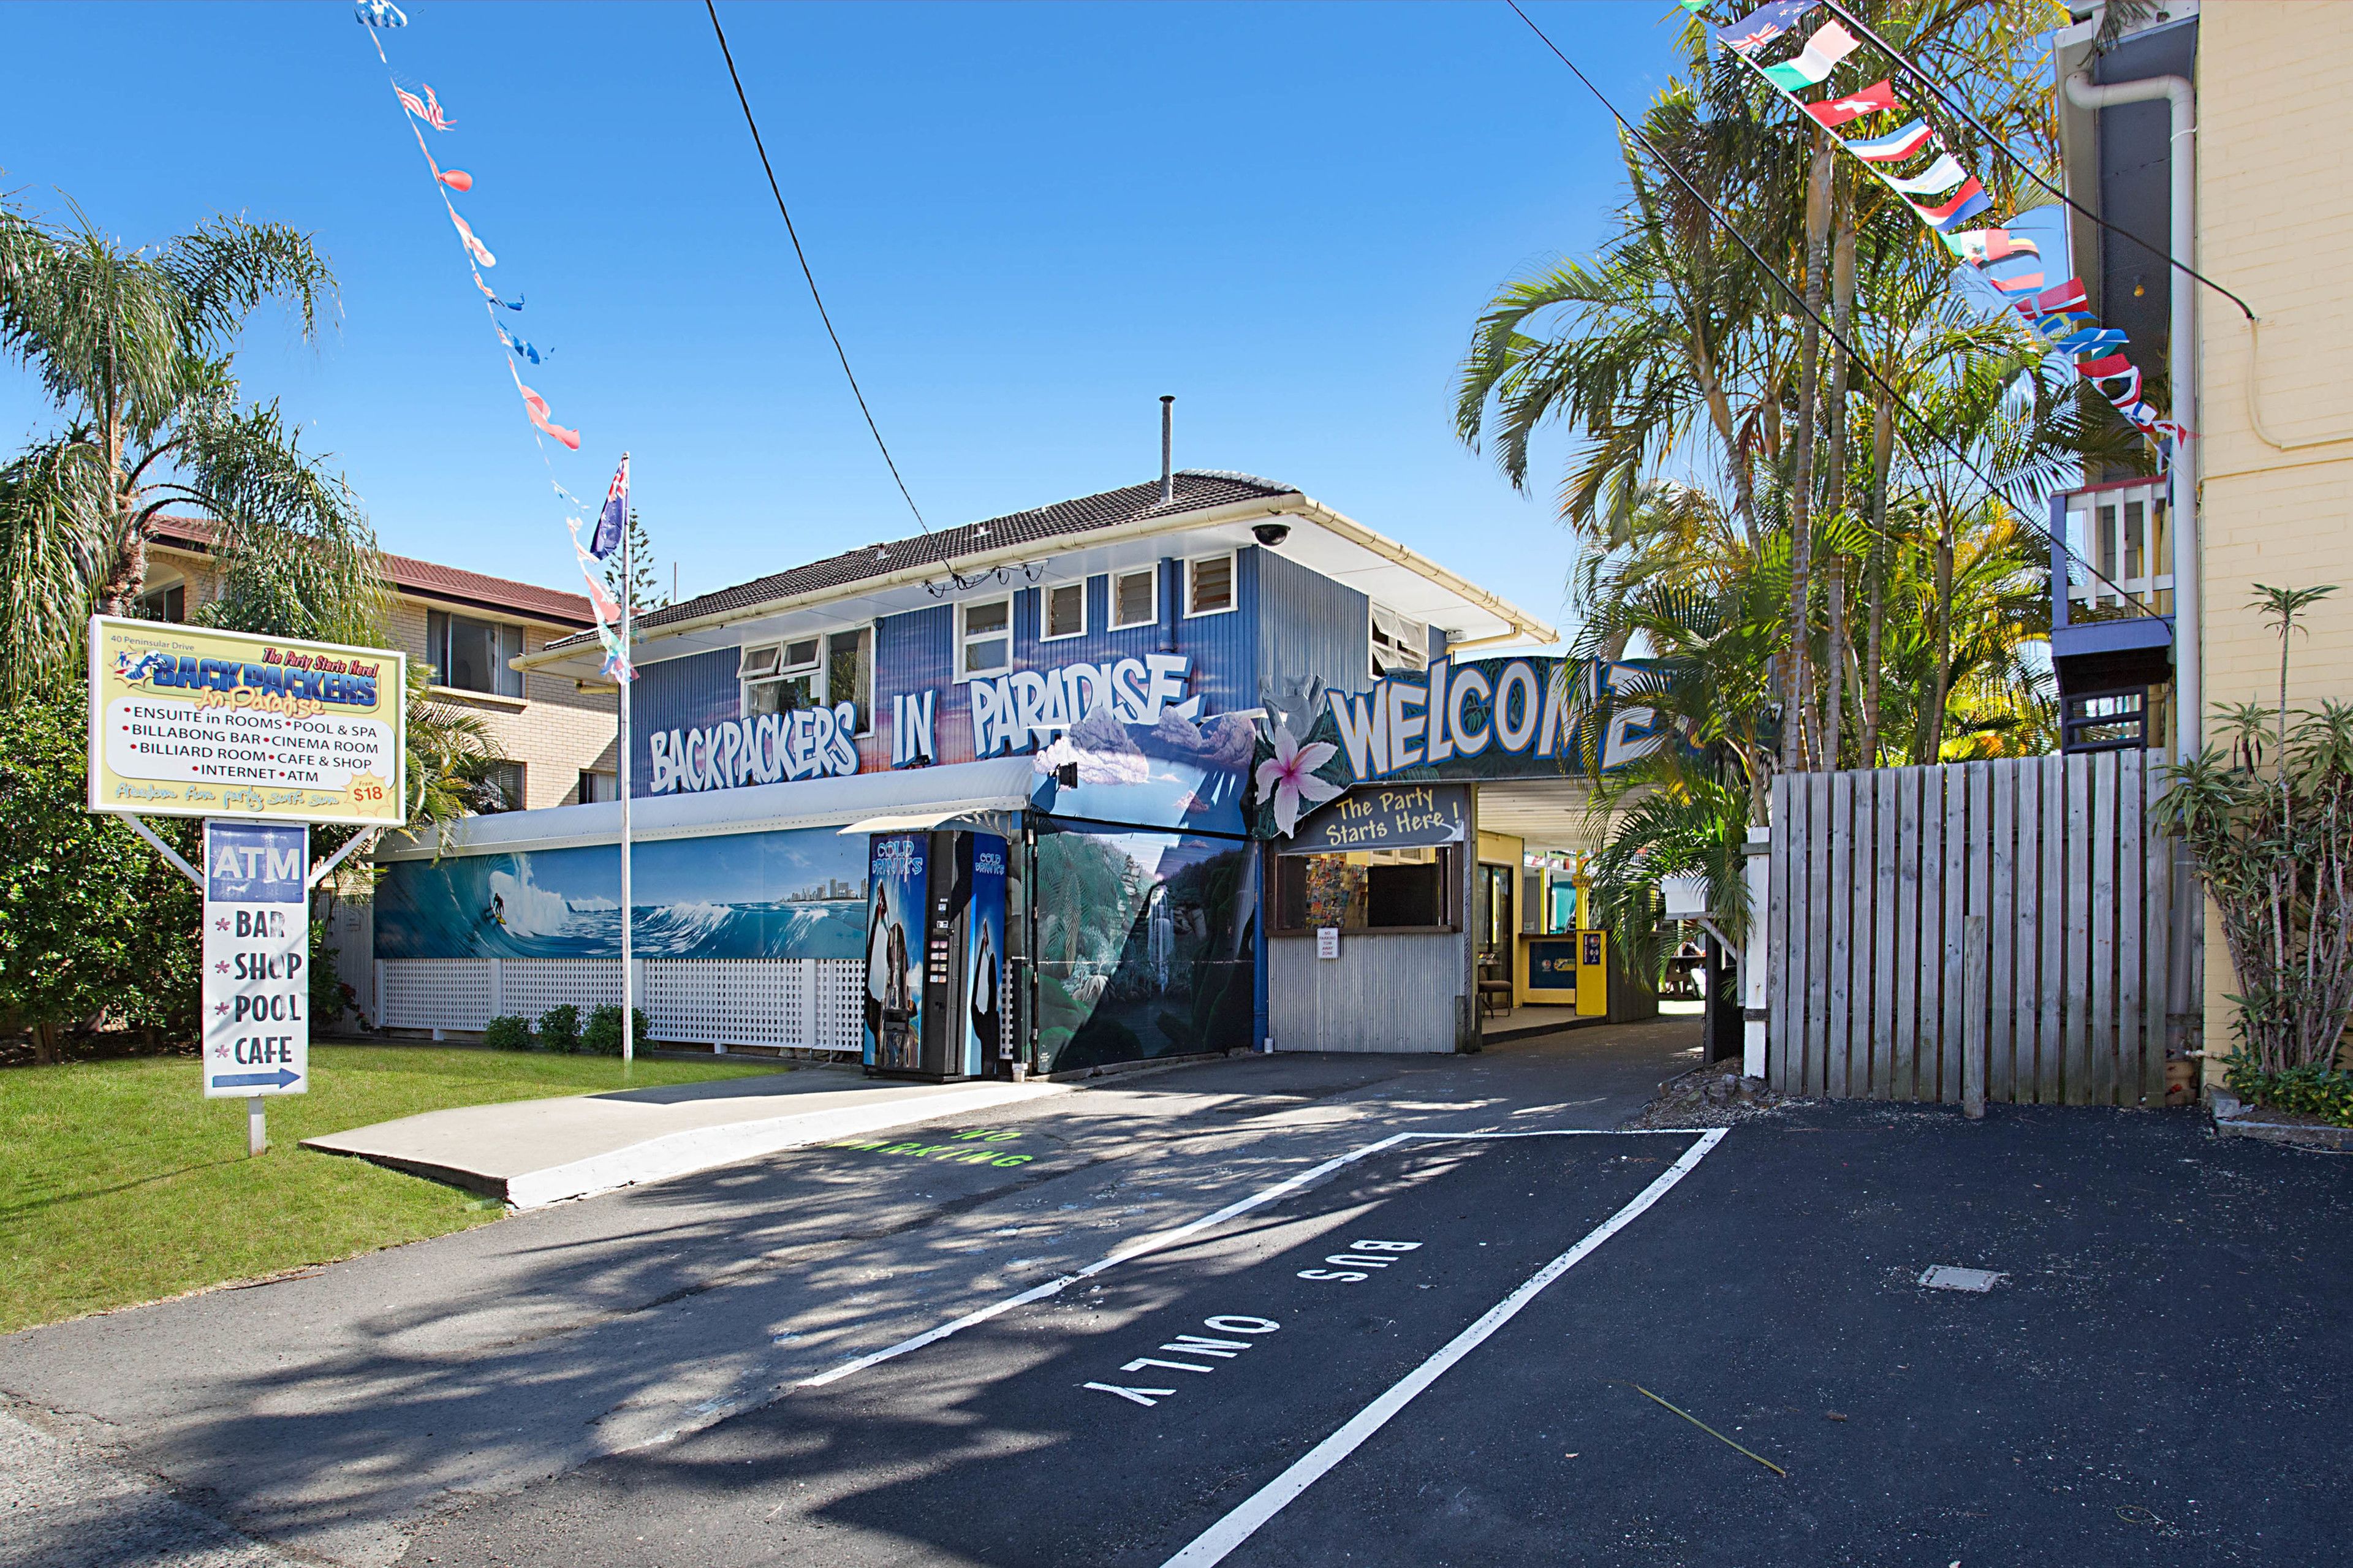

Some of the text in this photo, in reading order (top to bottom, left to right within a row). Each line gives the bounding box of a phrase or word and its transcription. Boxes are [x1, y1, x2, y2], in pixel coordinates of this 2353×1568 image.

[124, 636, 170, 648] Peninsular
[172, 642, 194, 651] Drive
[262, 647, 379, 678] The Party Starts Here!
[194, 686, 325, 719] In Paradise
[134, 706, 377, 738] ENSUITE in ROOMS POOL & SPA
[650, 653, 1208, 795] BACKPACKERS IN PARADISE
[1325, 654, 1672, 783] WELCOME
[132, 724, 378, 754] BILLABONG BAR CINEMA ROOM
[140, 742, 371, 769] BILLIARD ROOM CAFE & SHOP
[202, 765, 318, 782] INTERNET ATM
[115, 782, 177, 801] freedom
[186, 784, 215, 800] fun
[224, 785, 263, 812] party
[354, 786, 383, 802] $18
[1336, 787, 1433, 820] The Party
[1326, 820, 1388, 846] Starts
[212, 846, 300, 880] ATM
[877, 841, 914, 858] COLD
[980, 853, 1001, 863] COLD
[872, 857, 923, 876] DRINKS
[236, 911, 285, 938] BAR
[235, 953, 302, 980] SHOP
[235, 994, 301, 1023] POOL
[235, 1037, 292, 1064] CAFE
[951, 1129, 1022, 1142] NO
[1296, 1239, 1423, 1282] BUS
[1083, 1314, 1281, 1407] ONLY
